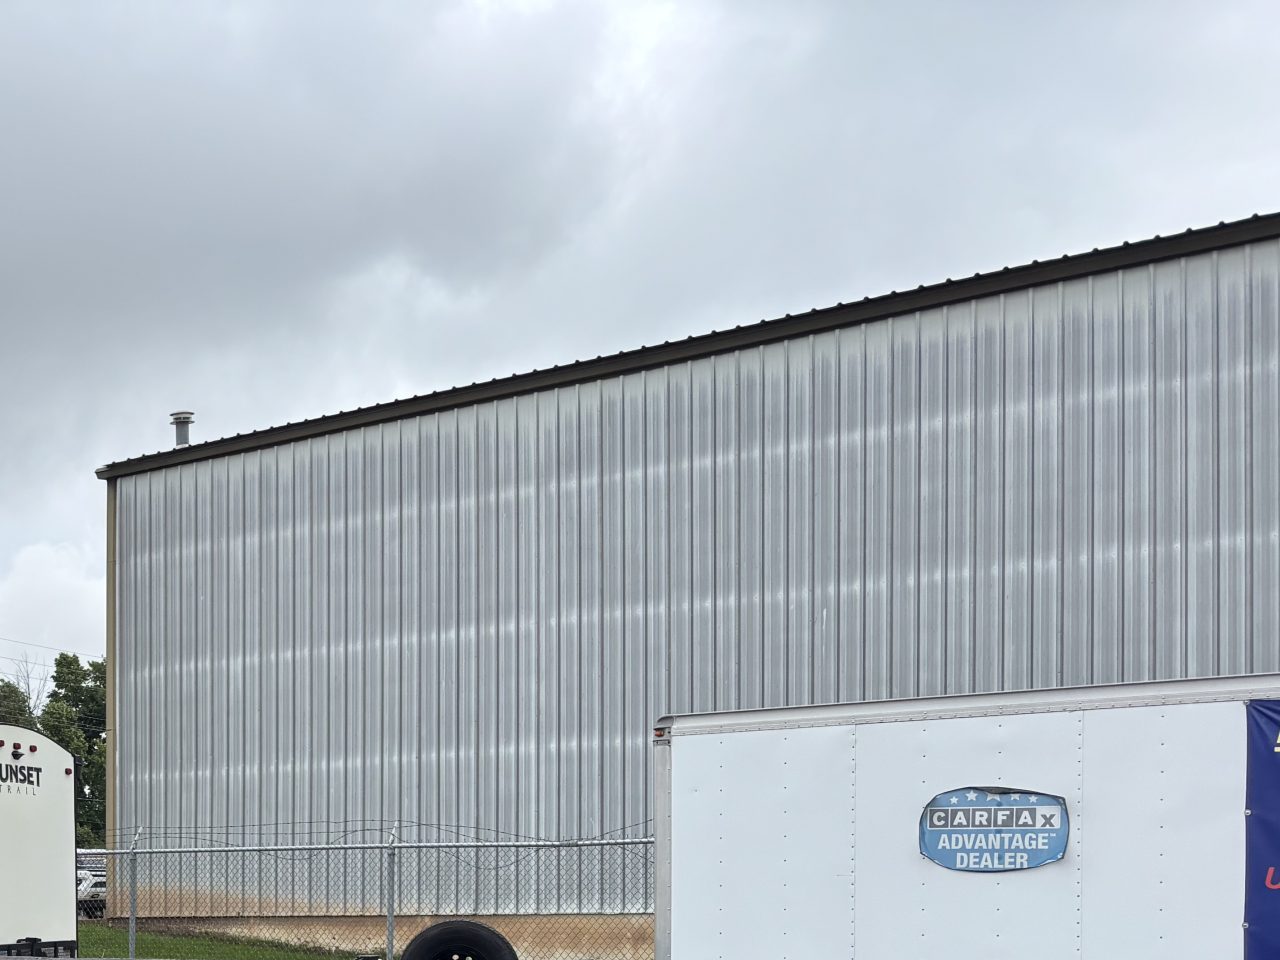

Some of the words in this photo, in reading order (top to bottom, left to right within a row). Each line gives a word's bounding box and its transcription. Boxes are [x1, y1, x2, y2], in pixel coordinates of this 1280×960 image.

[930, 808, 1058, 829] CARFAX
[938, 833, 1050, 850] ADVANTAGE
[956, 852, 1029, 869] DEALER
